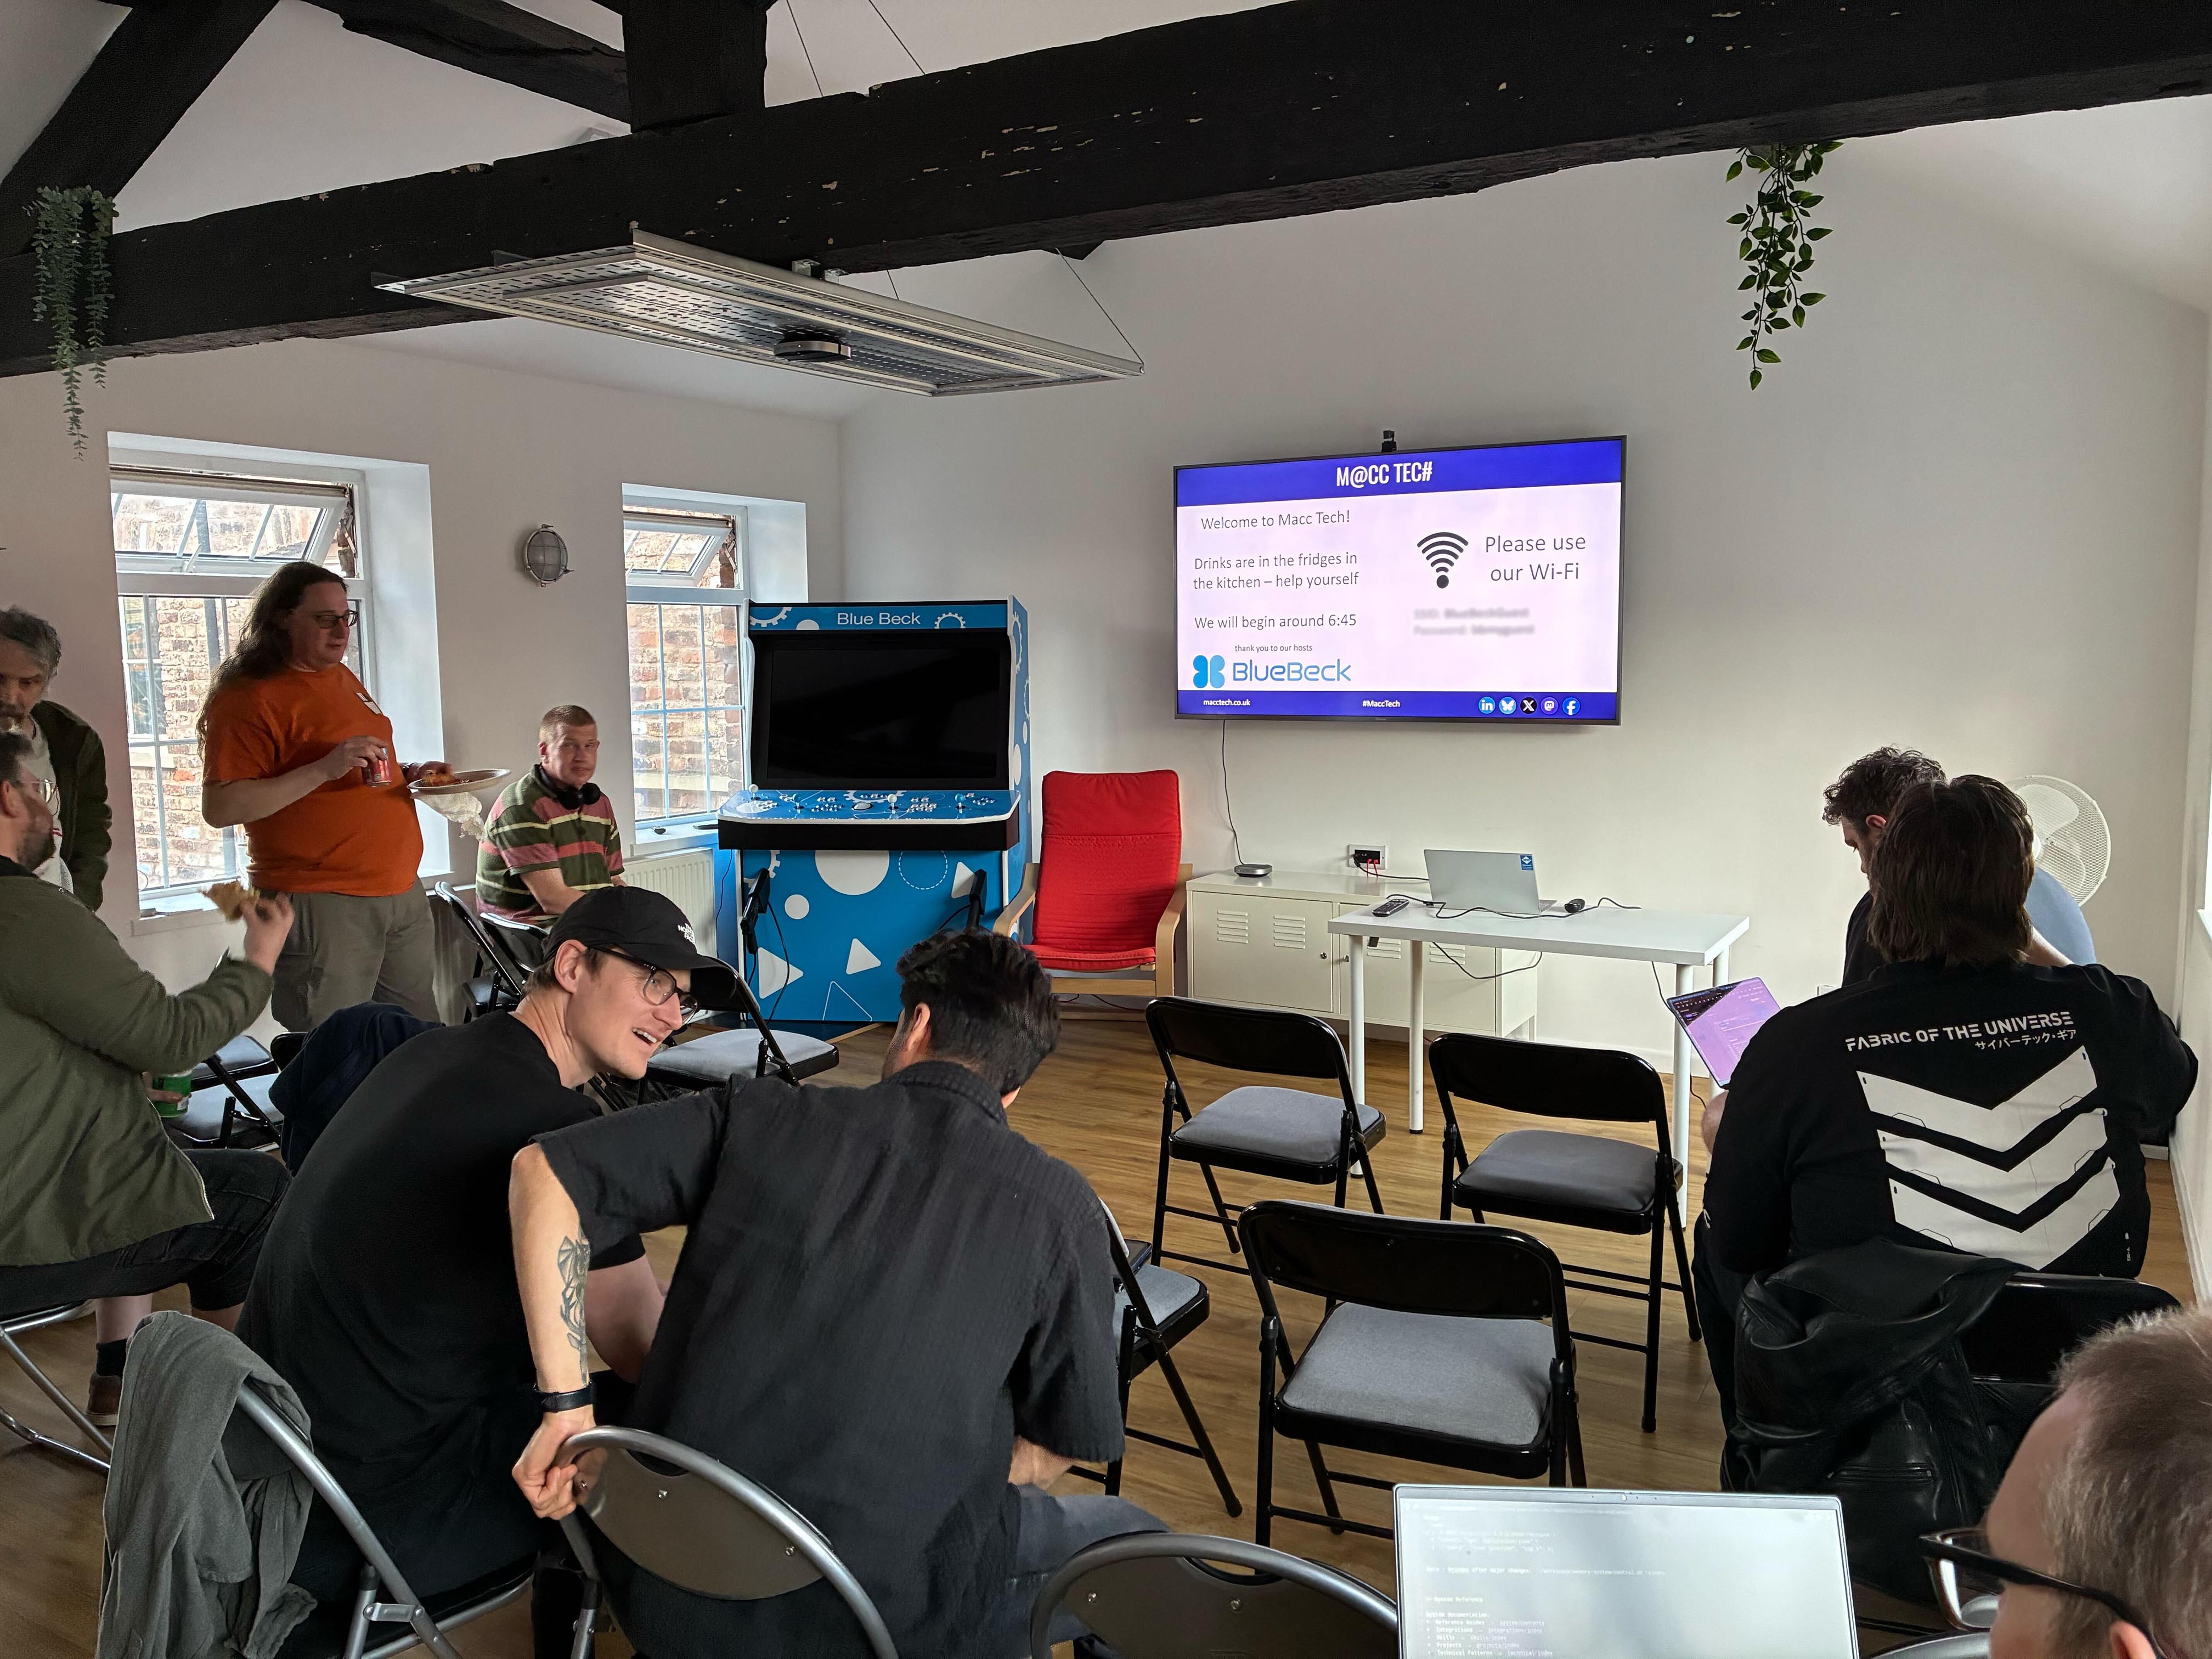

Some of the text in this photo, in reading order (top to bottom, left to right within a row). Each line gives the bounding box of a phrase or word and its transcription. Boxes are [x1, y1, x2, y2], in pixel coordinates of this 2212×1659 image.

[1336, 461, 1433, 488] M@CC TEC#
[1201, 510, 1350, 529] Welcome to Macc Tech!
[1486, 535, 1585, 553] Please use
[1195, 552, 1357, 569] Drinks are in the fridges in
[1193, 577, 1213, 589] the
[1217, 575, 1260, 589] kitchen
[1276, 574, 1302, 589] help
[1306, 572, 1359, 589] yourself
[1491, 562, 1579, 582] our Wi-Fi
[837, 612, 921, 625] Blue Beck
[1194, 614, 1356, 630] We will begin around 6:45
[1233, 658, 1351, 681] BlueBeck
[1845, 1011, 2074, 1052] FABRIC OF THE UNIVERSE
[1975, 1029, 2076, 1050] サイバーテック・ギア
